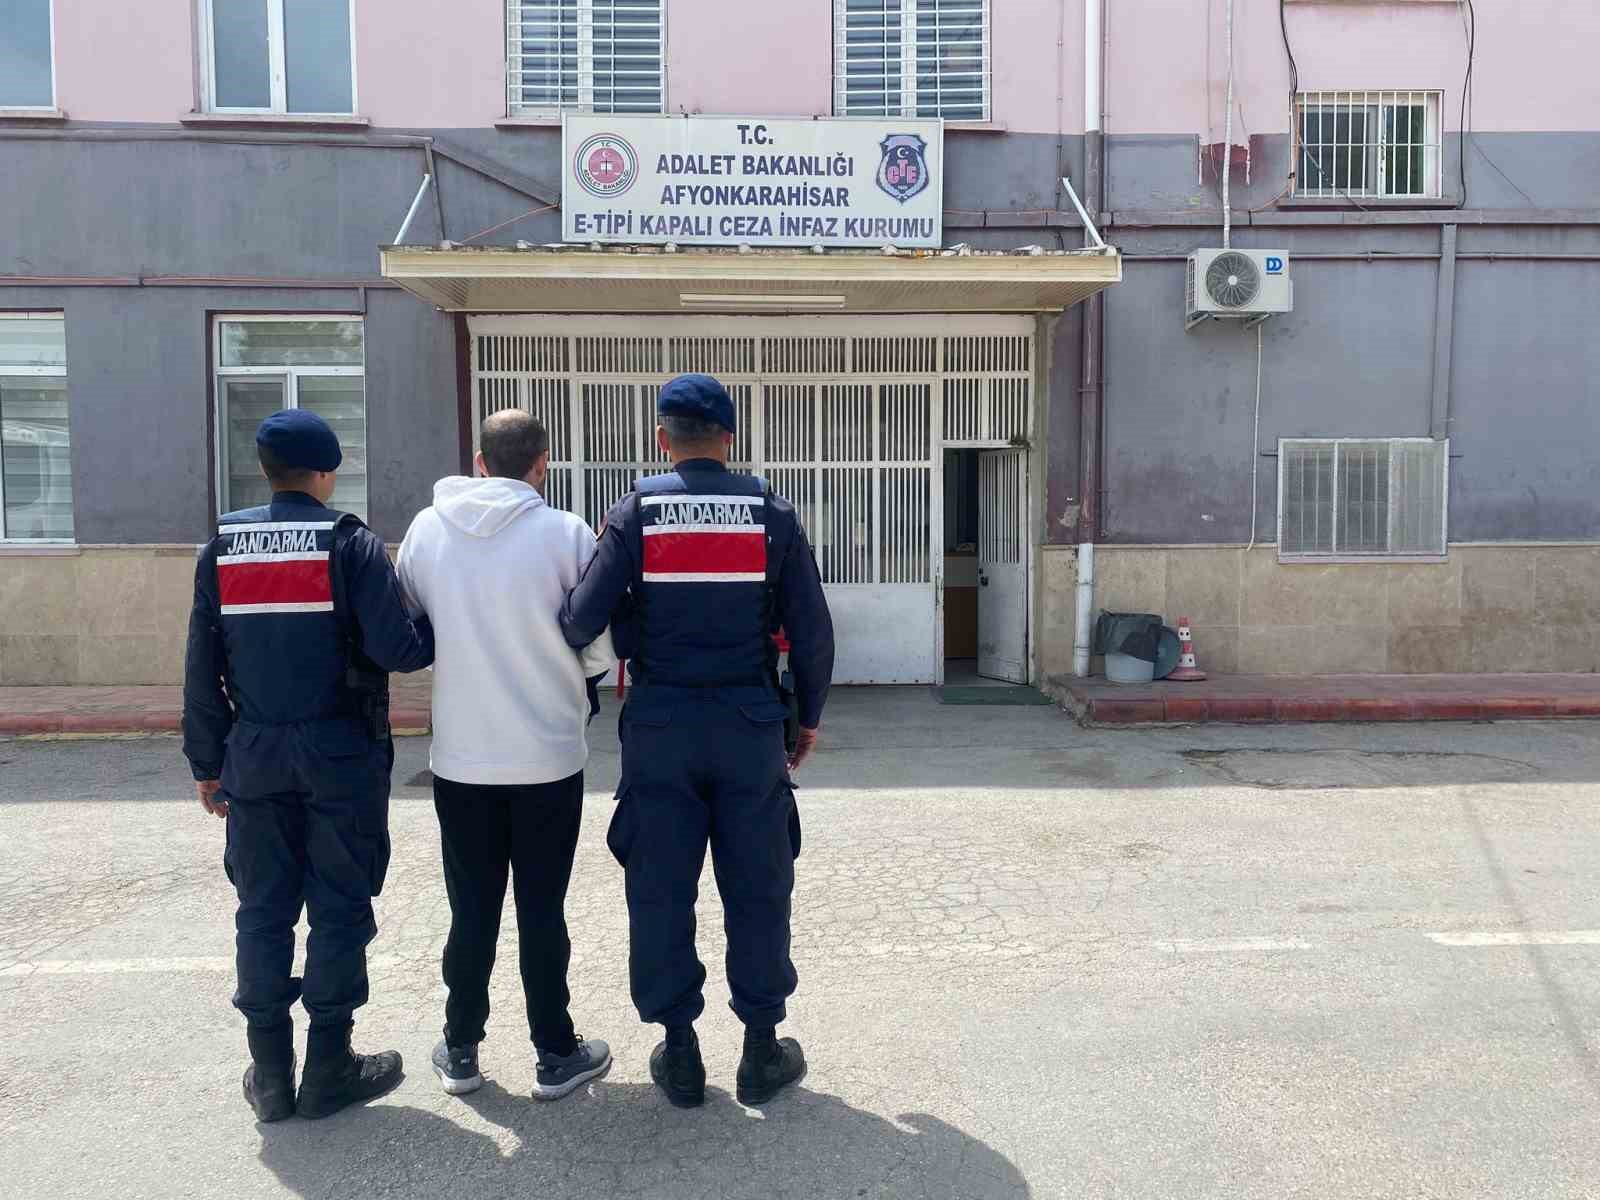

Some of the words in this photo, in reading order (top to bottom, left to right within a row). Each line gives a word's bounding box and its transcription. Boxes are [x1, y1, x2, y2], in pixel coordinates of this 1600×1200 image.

[737, 124, 774, 145] T.C.
[656, 154, 736, 175] ADALET
[742, 152, 854, 177] BAKANLIĞI
[660, 181, 850, 207] AFYONKARAHİSAR
[574, 209, 632, 235] E-TİPİ
[640, 215, 712, 236] KAPALI
[719, 216, 773, 237] CEZA
[780, 212, 839, 237] İNFAZ
[845, 218, 934, 238] KURUMU
[655, 503, 754, 525] JANDARMA
[227, 529, 318, 555] JANDARMA
